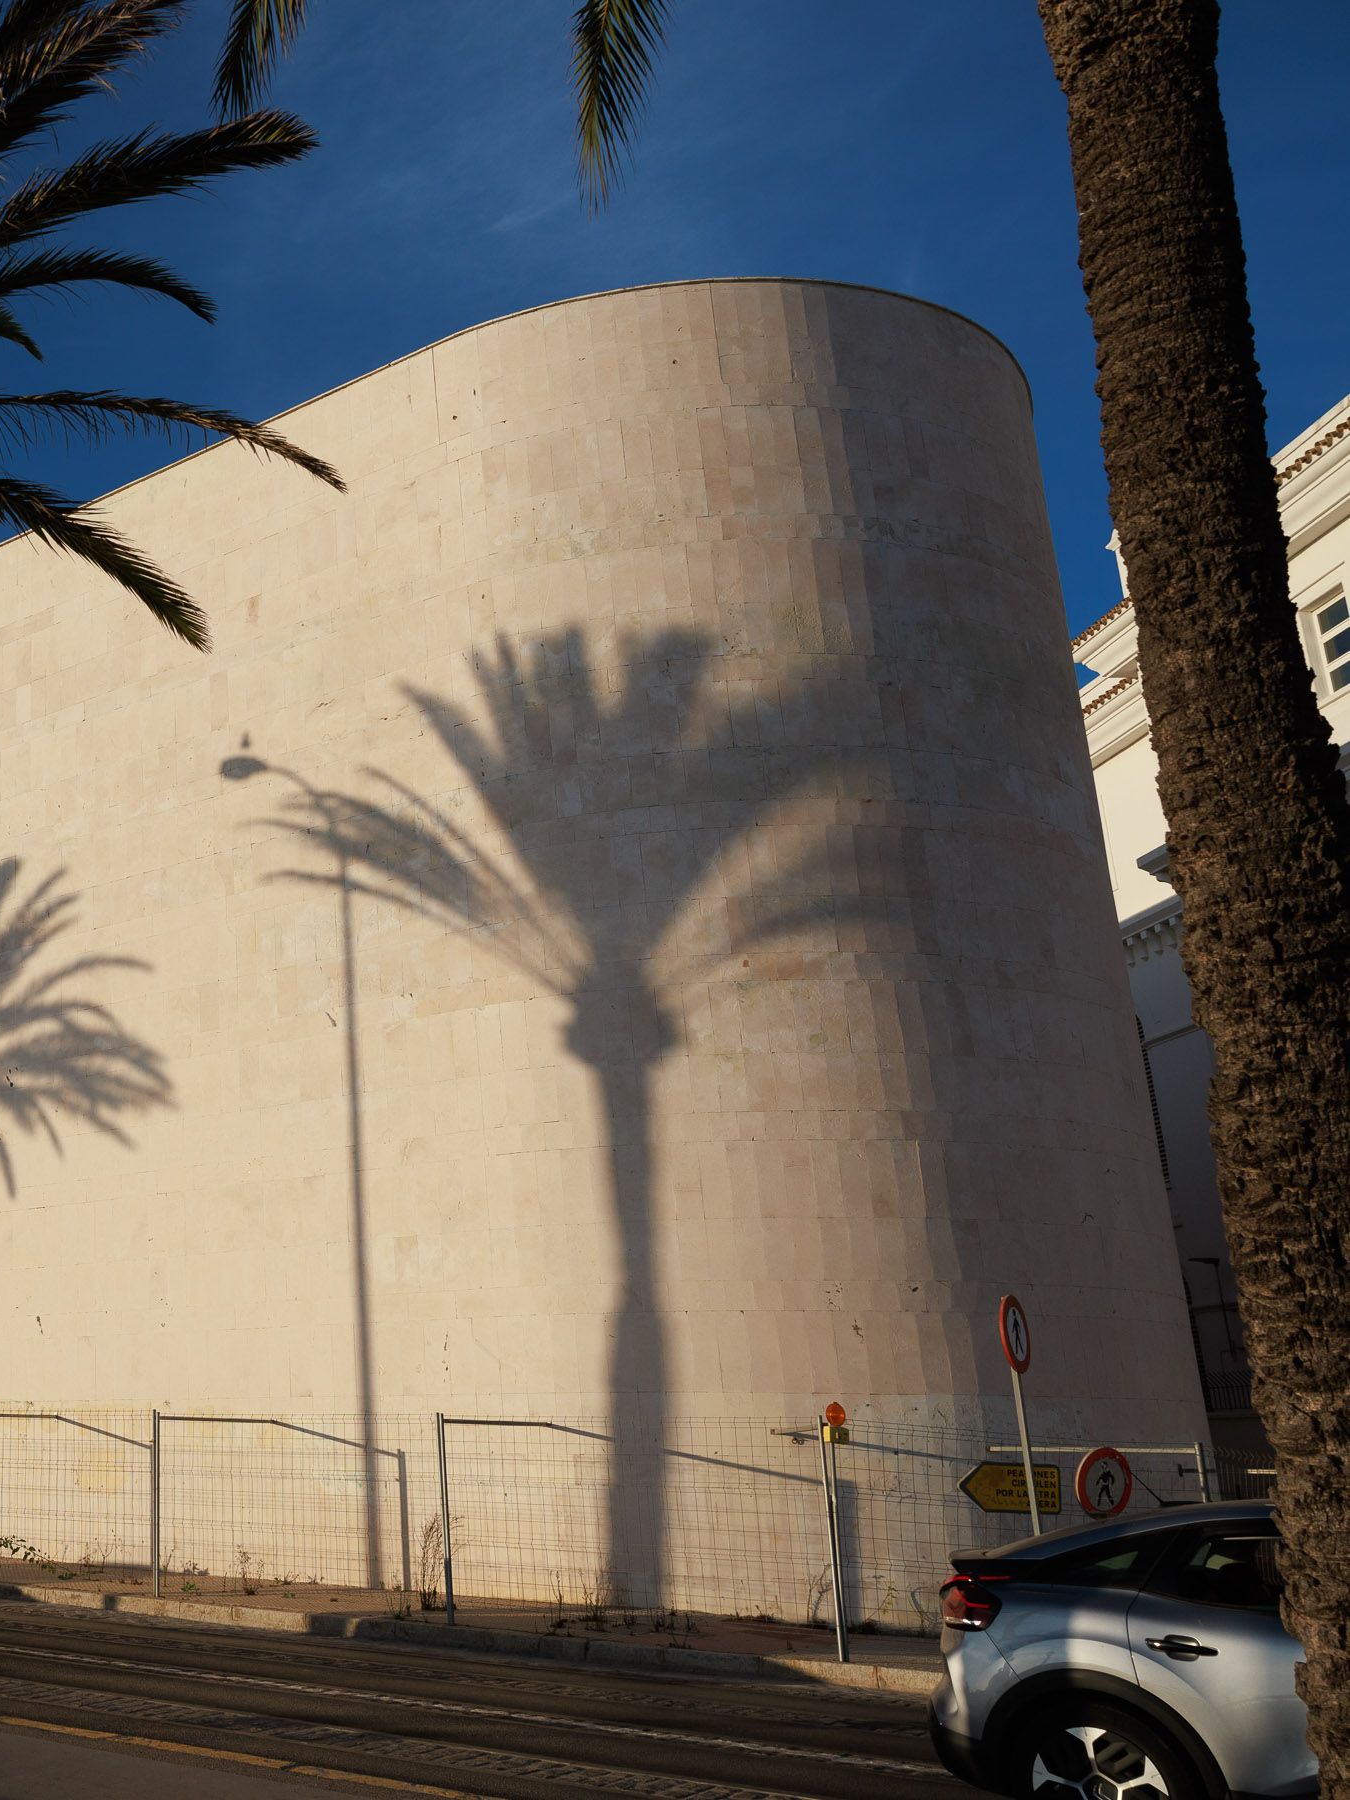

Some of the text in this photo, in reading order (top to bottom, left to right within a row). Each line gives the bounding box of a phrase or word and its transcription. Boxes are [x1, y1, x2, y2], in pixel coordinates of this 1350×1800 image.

[1007, 1469, 1056, 1479] PEANES
[1011, 1479, 1056, 1489] CIRULEN
[996, 1488, 1014, 1497] POR
[1017, 1489, 1028, 1498] LA
[1026, 1500, 1057, 1508] AERA
